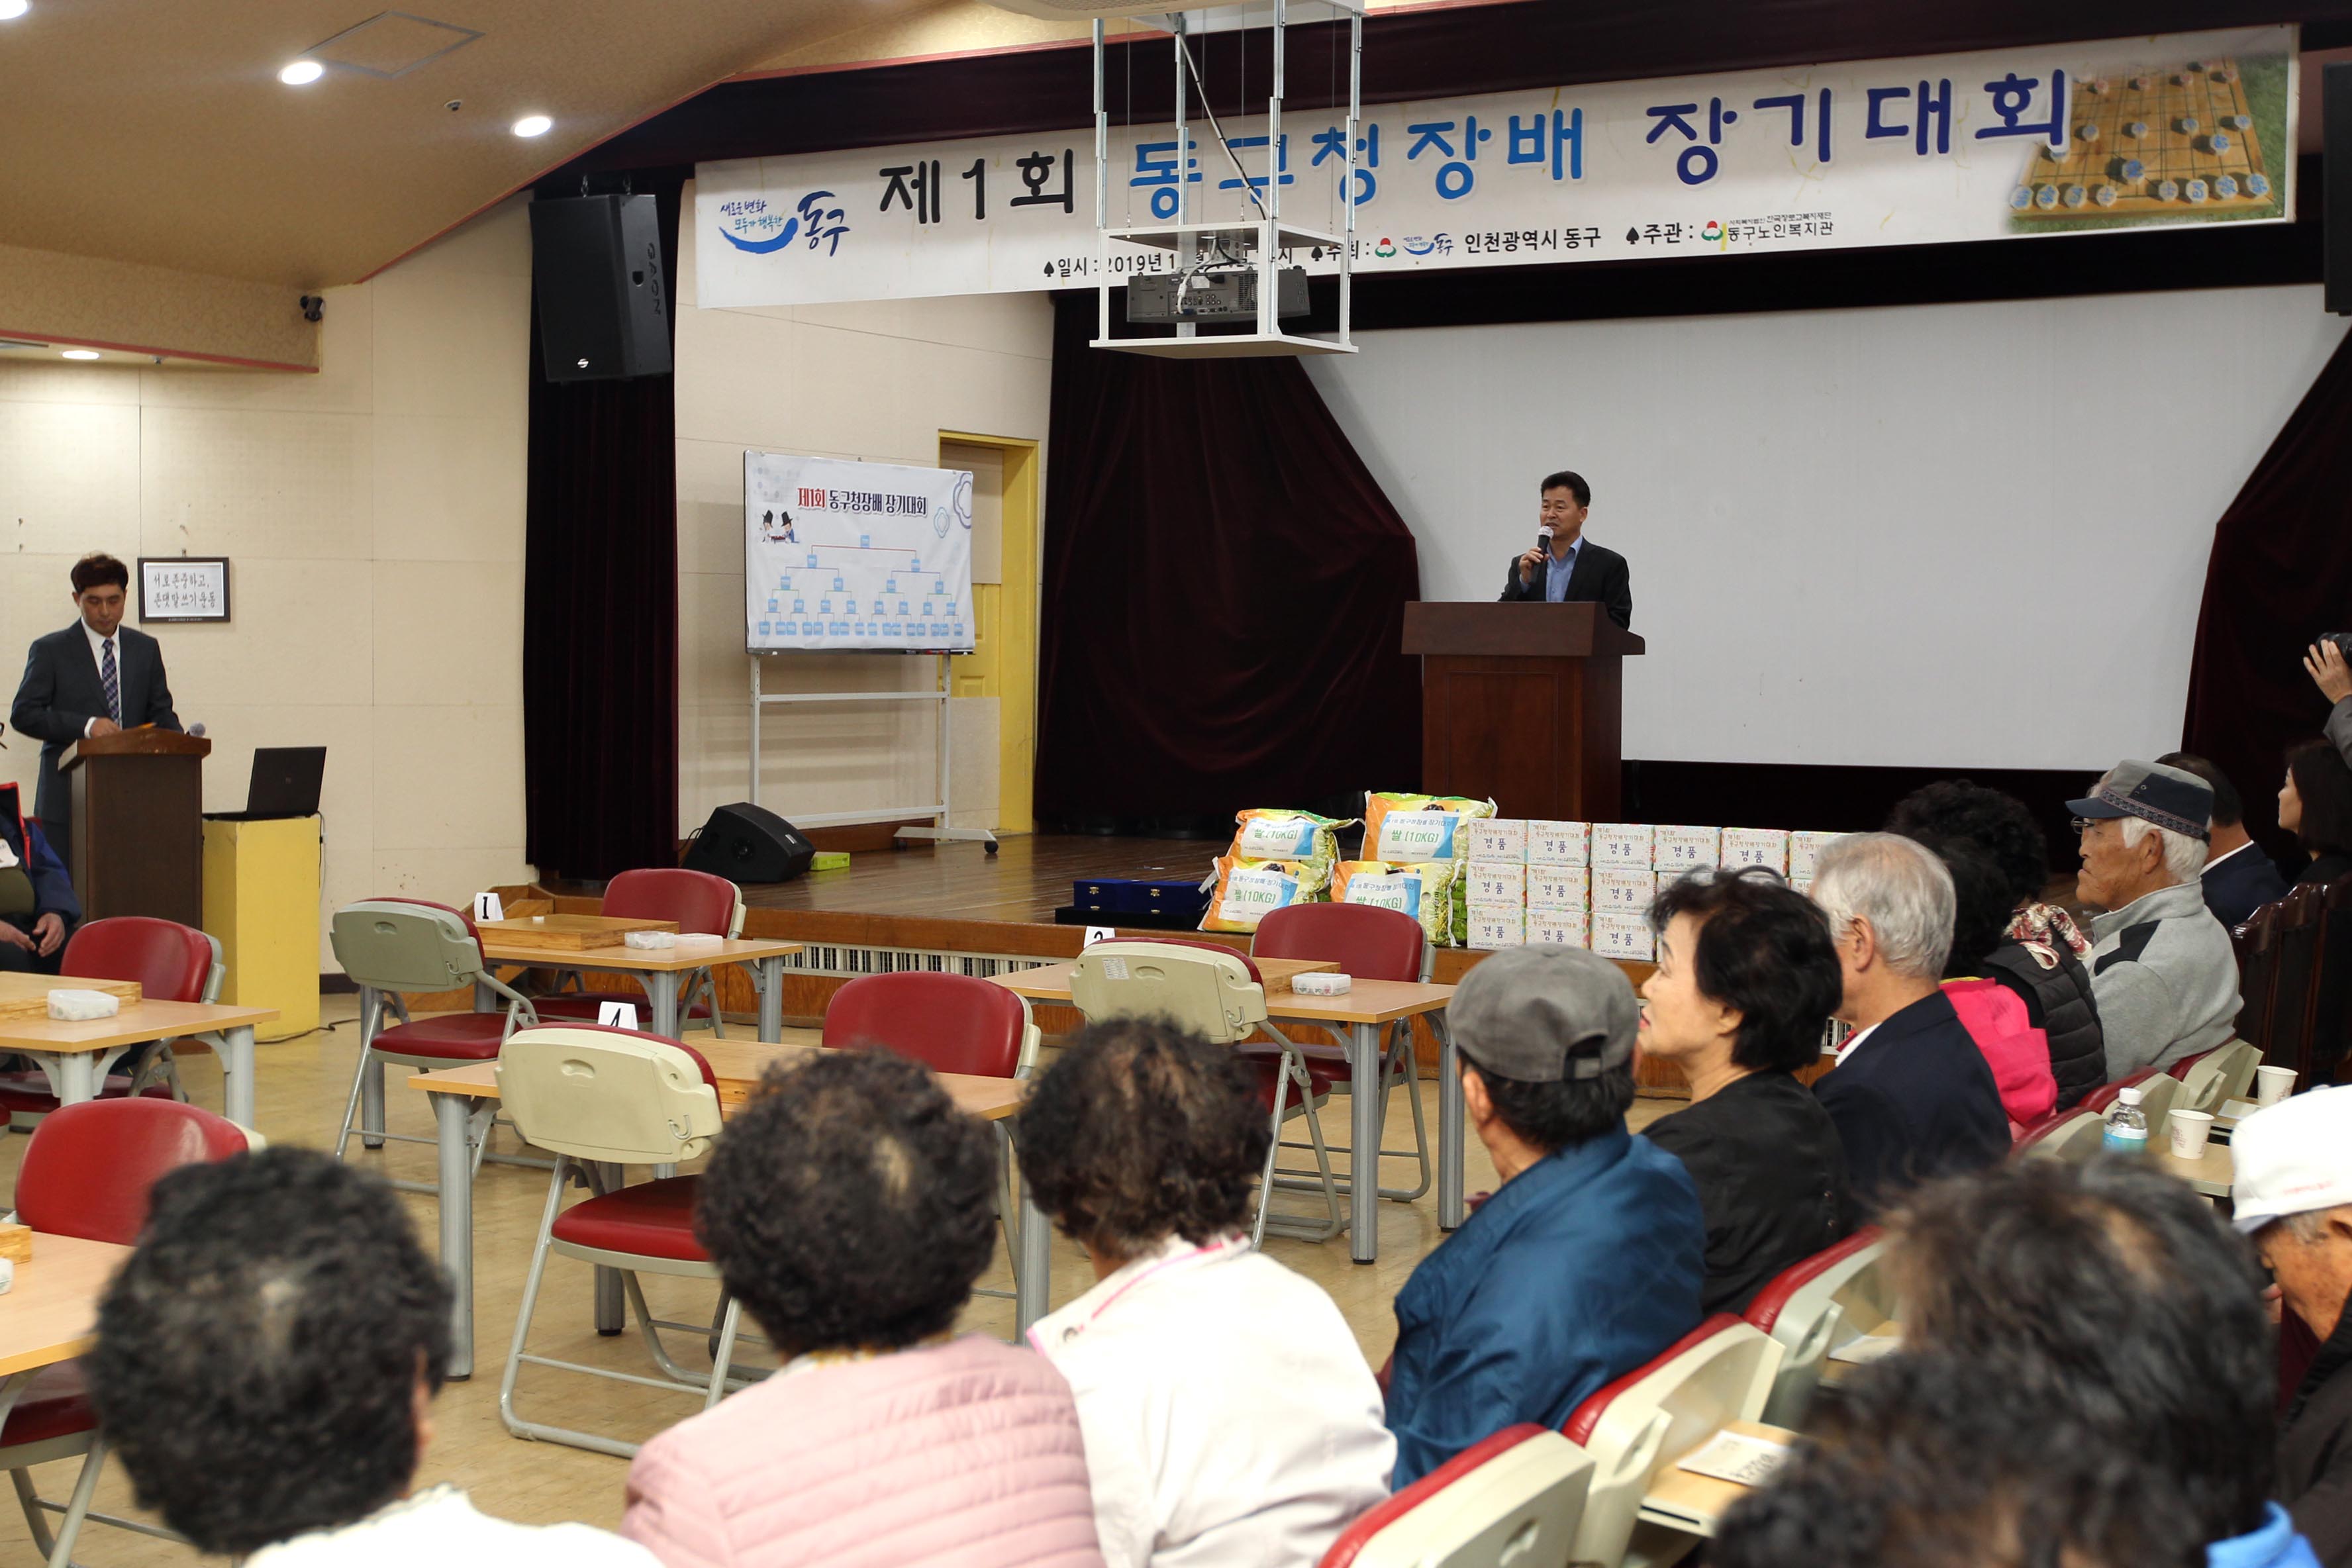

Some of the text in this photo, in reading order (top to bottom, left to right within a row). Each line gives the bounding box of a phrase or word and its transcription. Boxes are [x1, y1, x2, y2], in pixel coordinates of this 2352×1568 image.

[1129, 107, 1583, 220] 동구청장배
[1645, 69, 2065, 185] 장기대회
[720, 199, 767, 216] 새로운 변화
[734, 215, 783, 234] 모두가 행복한
[797, 191, 850, 257] 동구
[1728, 222, 1834, 242] 동구노인복지관
[1465, 229, 1557, 254] 인천광역시
[1563, 228, 1602, 250] 동구
[797, 488, 926, 514] 제1회 동구청장배 장기대회
[1392, 830, 1402, 841] 쌀
[483, 897, 489, 919] 1
